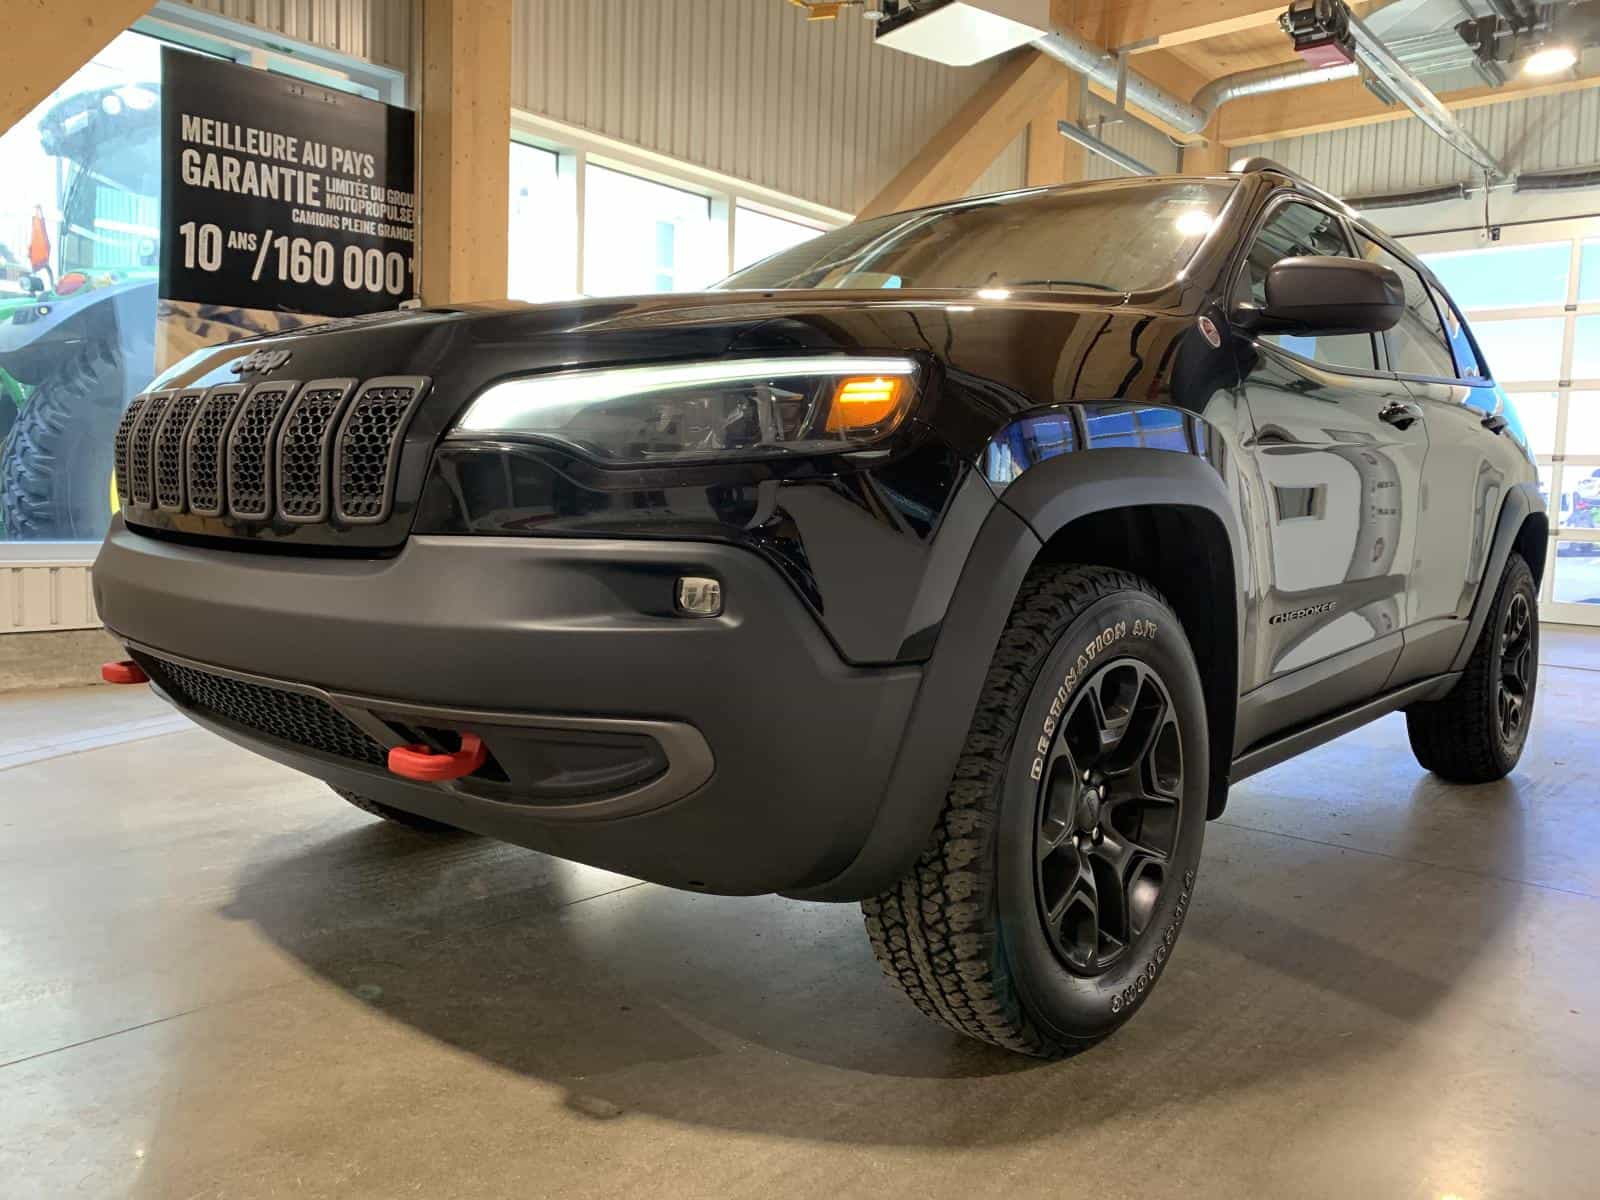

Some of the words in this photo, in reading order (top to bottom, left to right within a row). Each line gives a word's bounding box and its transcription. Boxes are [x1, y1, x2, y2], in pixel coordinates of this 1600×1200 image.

[182, 114, 298, 163] MEILLEURE
[302, 141, 327, 169] AU
[332, 146, 375, 178] PAYS
[182, 149, 321, 207] GARANTIE
[325, 176, 369, 200] LIMITÉE
[370, 184, 385, 202] DU
[292, 208, 340, 230] CAMIONS
[341, 216, 377, 236] PLEINE
[179, 221, 222, 272] 10
[343, 245, 404, 295] 000
[1269, 601, 1336, 625] CHEROKEE
[1031, 620, 1127, 780] DESTINATION
[1132, 619, 1158, 639] A/T
